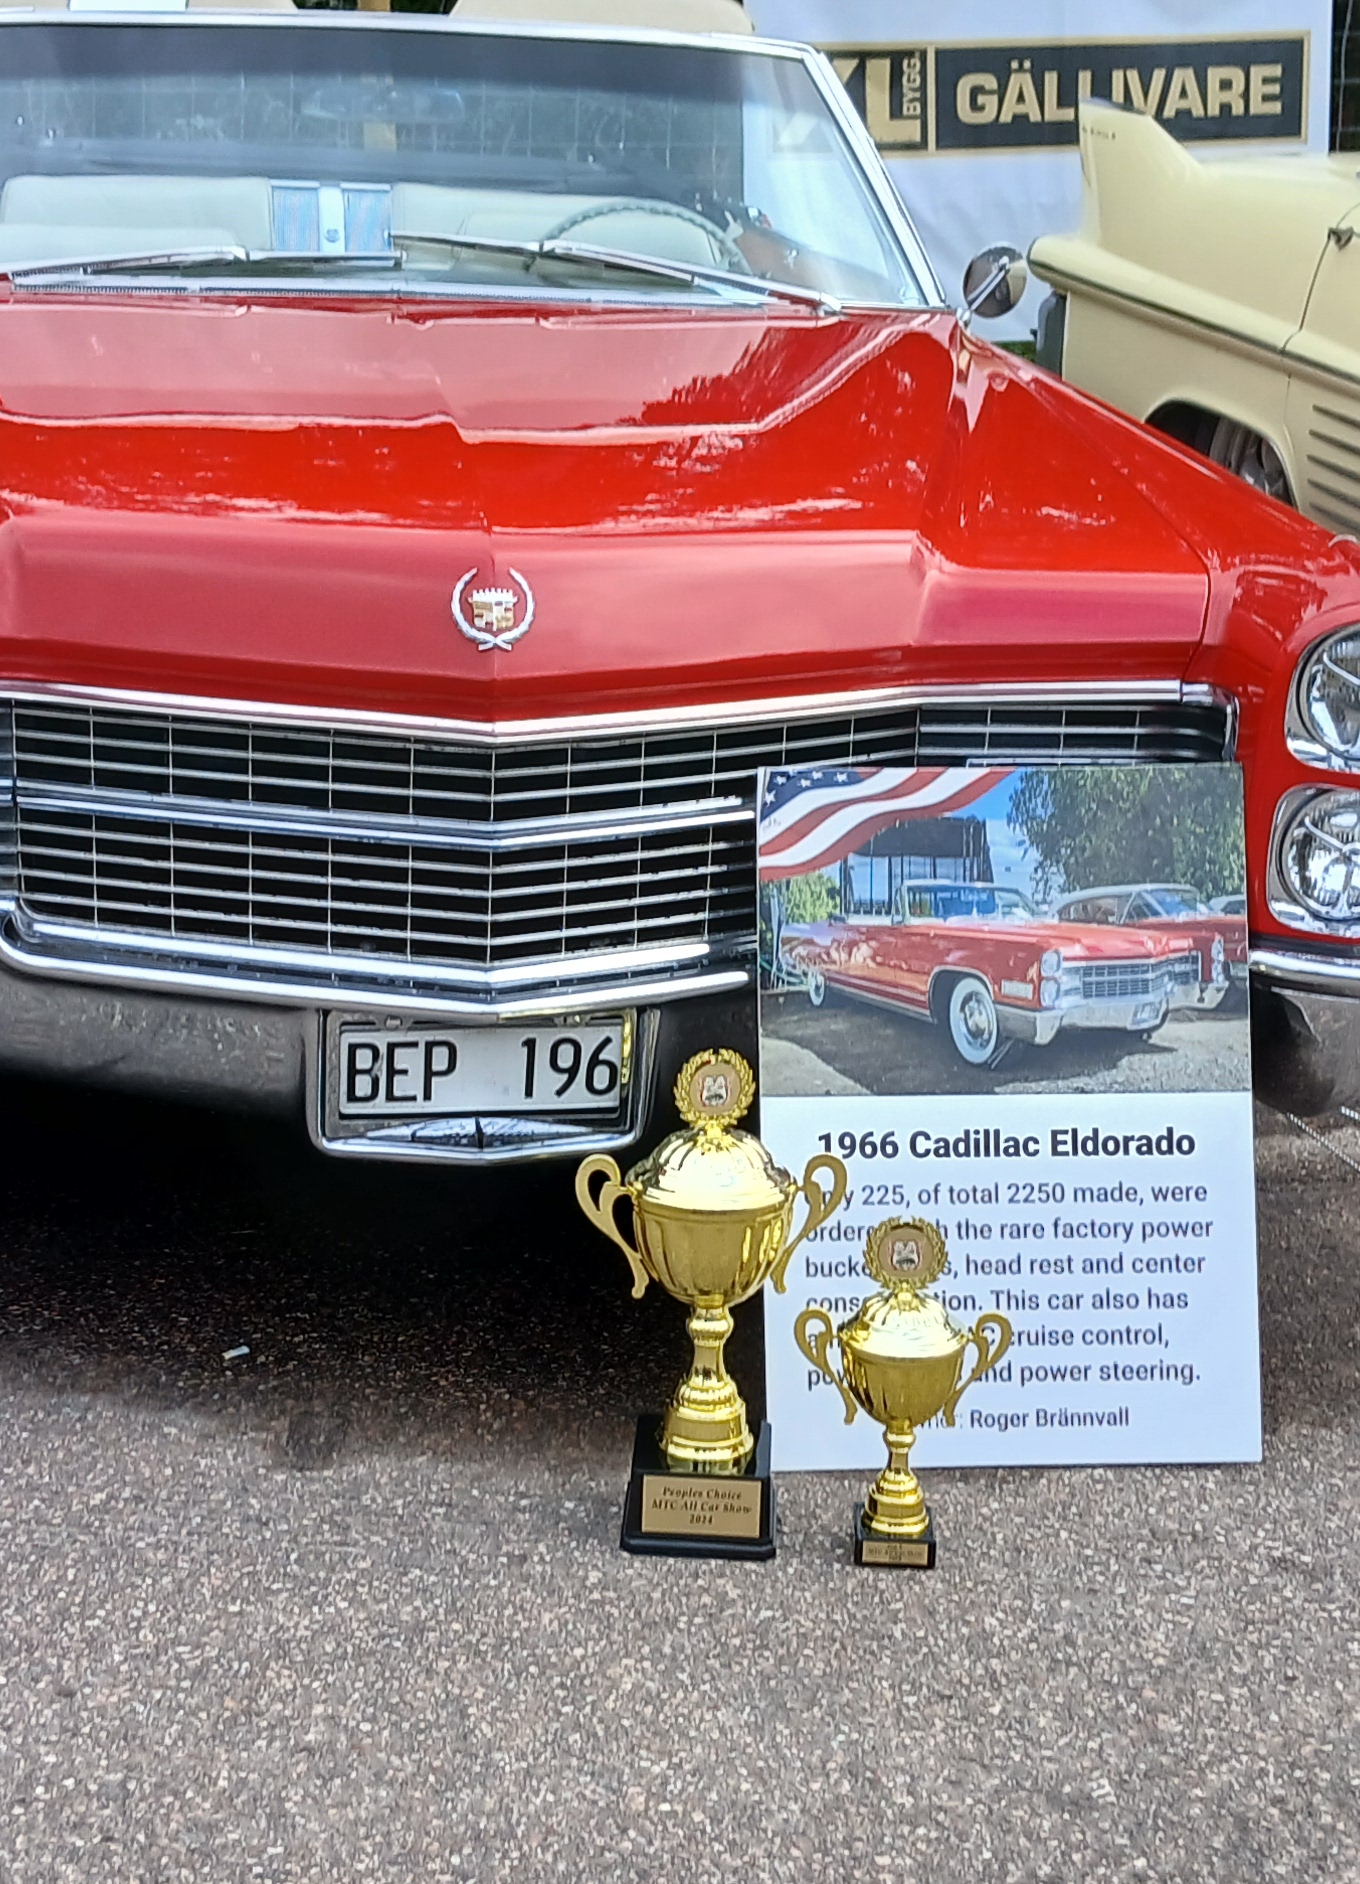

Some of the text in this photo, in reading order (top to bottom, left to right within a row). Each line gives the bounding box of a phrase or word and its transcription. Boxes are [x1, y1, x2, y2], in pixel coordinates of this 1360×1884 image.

[346, 1036, 619, 1103] BEP 196
[818, 1126, 1196, 1159] 1966 Cadillac Eldorado
[862, 1185, 911, 1208] 225,
[918, 1183, 941, 1205] of
[948, 1182, 999, 1205] total
[1007, 1183, 1065, 1204] 2250
[1073, 1180, 1144, 1206] made,
[1151, 1184, 1207, 1202] were
[806, 1219, 875, 1242] order
[956, 1218, 992, 1240] the
[1000, 1223, 1045, 1240] rare
[1053, 1217, 1134, 1244] factory
[1142, 1220, 1214, 1243] power
[965, 1253, 1022, 1275] head
[1029, 1255, 1074, 1275] rest
[1081, 1252, 1124, 1274] and
[1131, 1253, 1206, 1274] center
[990, 1288, 1040, 1311] This
[1047, 1293, 1084, 1310] car
[1091, 1287, 1140, 1310] also
[1147, 1287, 1189, 1309] has
[1011, 1324, 1074, 1347] ruise
[1081, 1322, 1169, 1349] control,
[1020, 1364, 1092, 1387] power
[1098, 1359, 1201, 1386] steering.
[970, 1409, 1029, 1432] Roger
[1035, 1406, 1130, 1428] Brännvall
[663, 1486, 742, 1500] Peoples Choice
[680, 1499, 697, 1511] All
[700, 1501, 720, 1513] Car
[723, 1502, 752, 1514] Show
